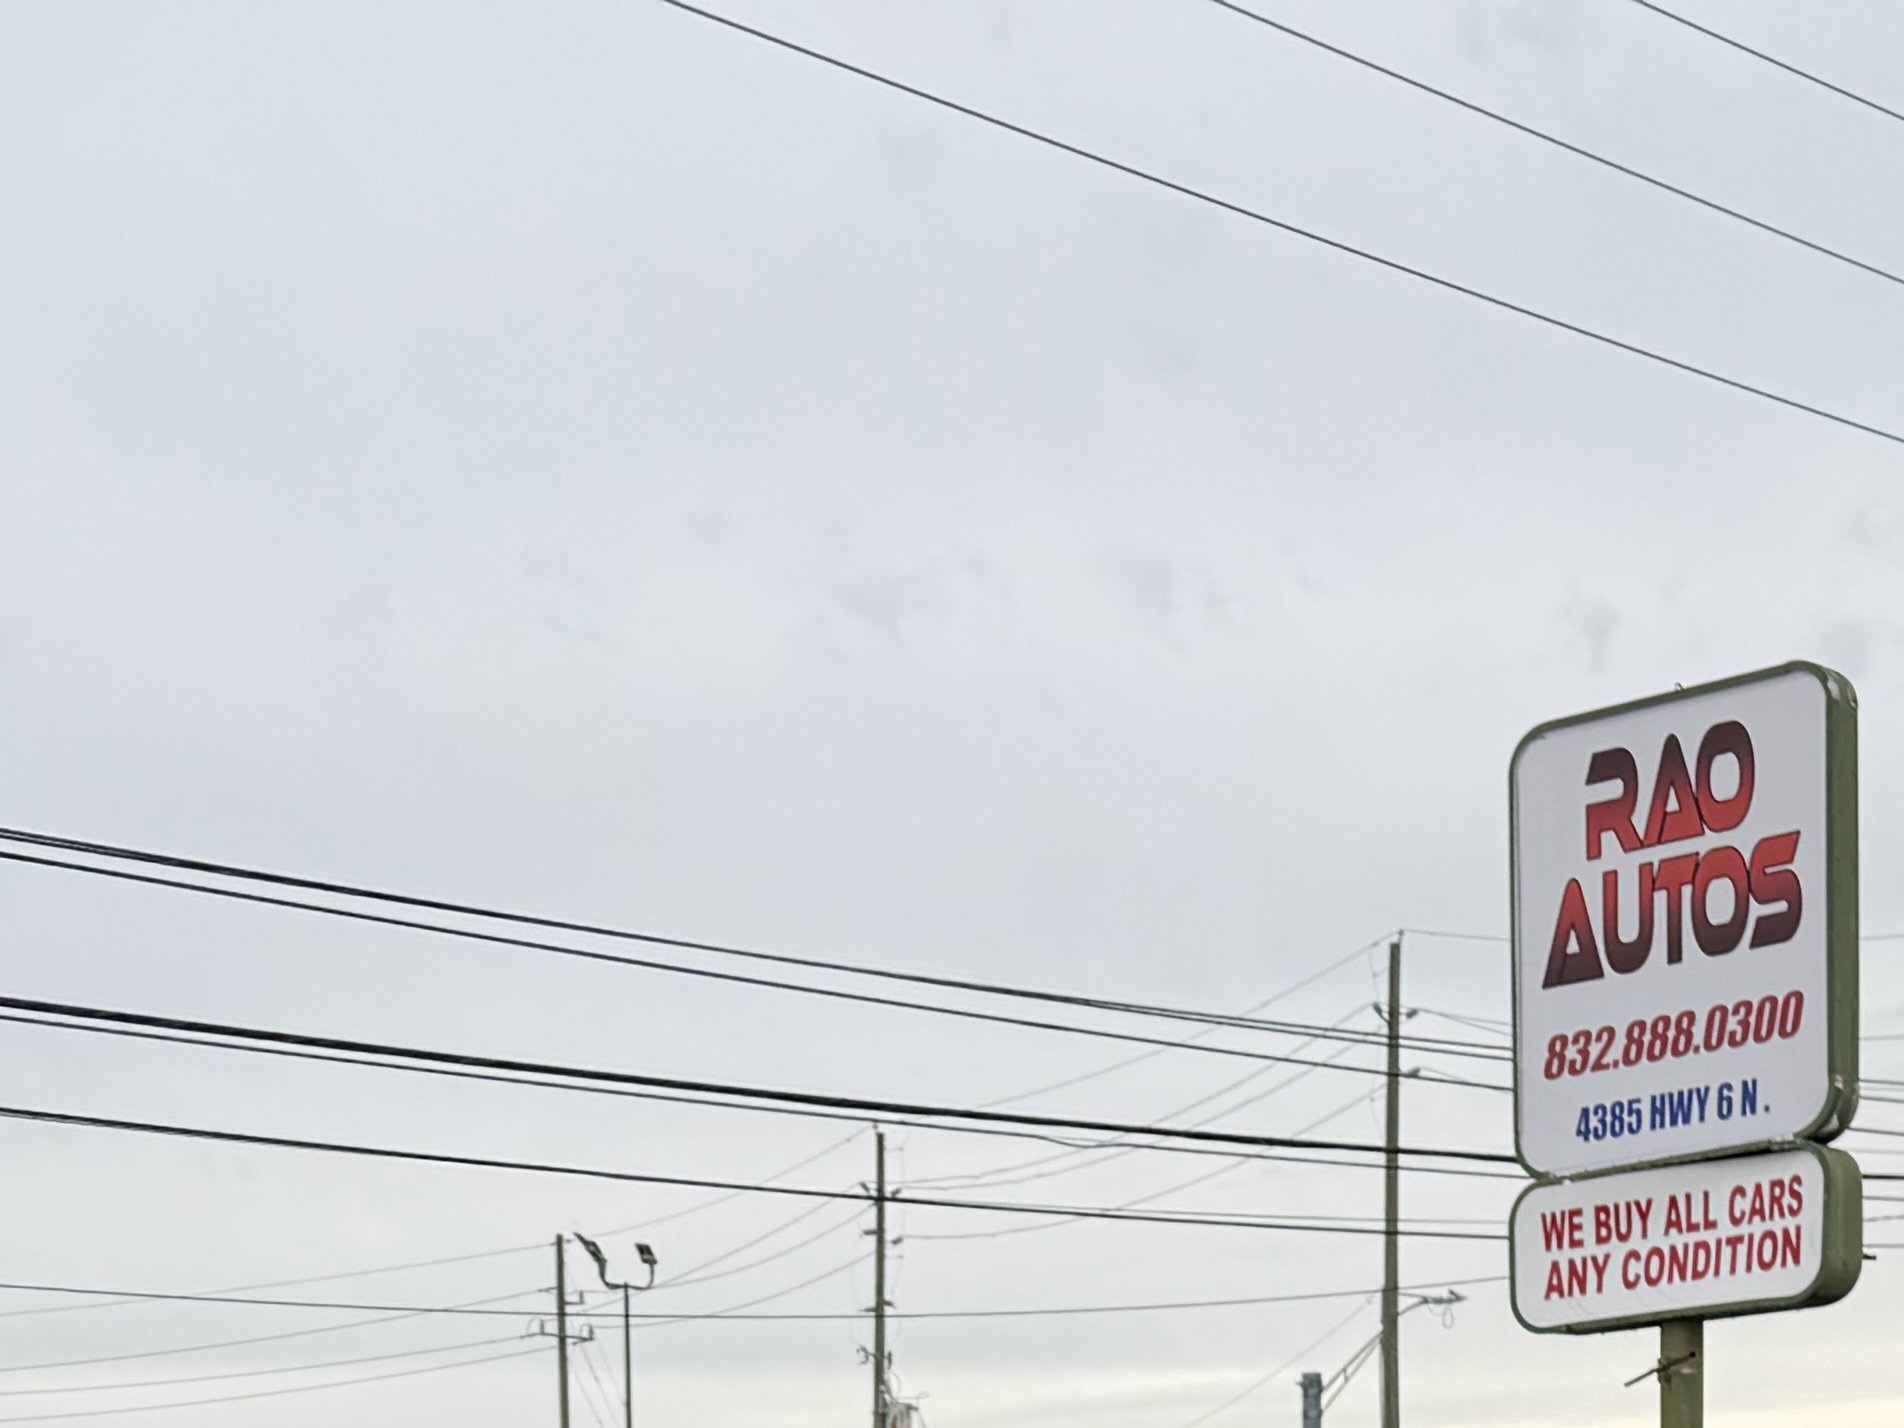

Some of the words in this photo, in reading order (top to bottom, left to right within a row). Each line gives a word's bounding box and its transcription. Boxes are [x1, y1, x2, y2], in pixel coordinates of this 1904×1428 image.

[1585, 719, 1756, 861] RAO
[1541, 829, 1804, 990] AUTOS
[1542, 990, 1805, 1081] 832.888.0300
[1575, 1091, 1643, 1144] 4385
[1648, 1082, 1713, 1133] HWY
[1715, 1080, 1735, 1124] 6
[1541, 1207, 1584, 1253] WE
[1593, 1197, 1655, 1246] BUY
[1662, 1188, 1719, 1237] ALL
[1727, 1174, 1804, 1227] CARS
[1543, 1248, 1611, 1301] ANY
[1620, 1225, 1803, 1291] CONDITION
